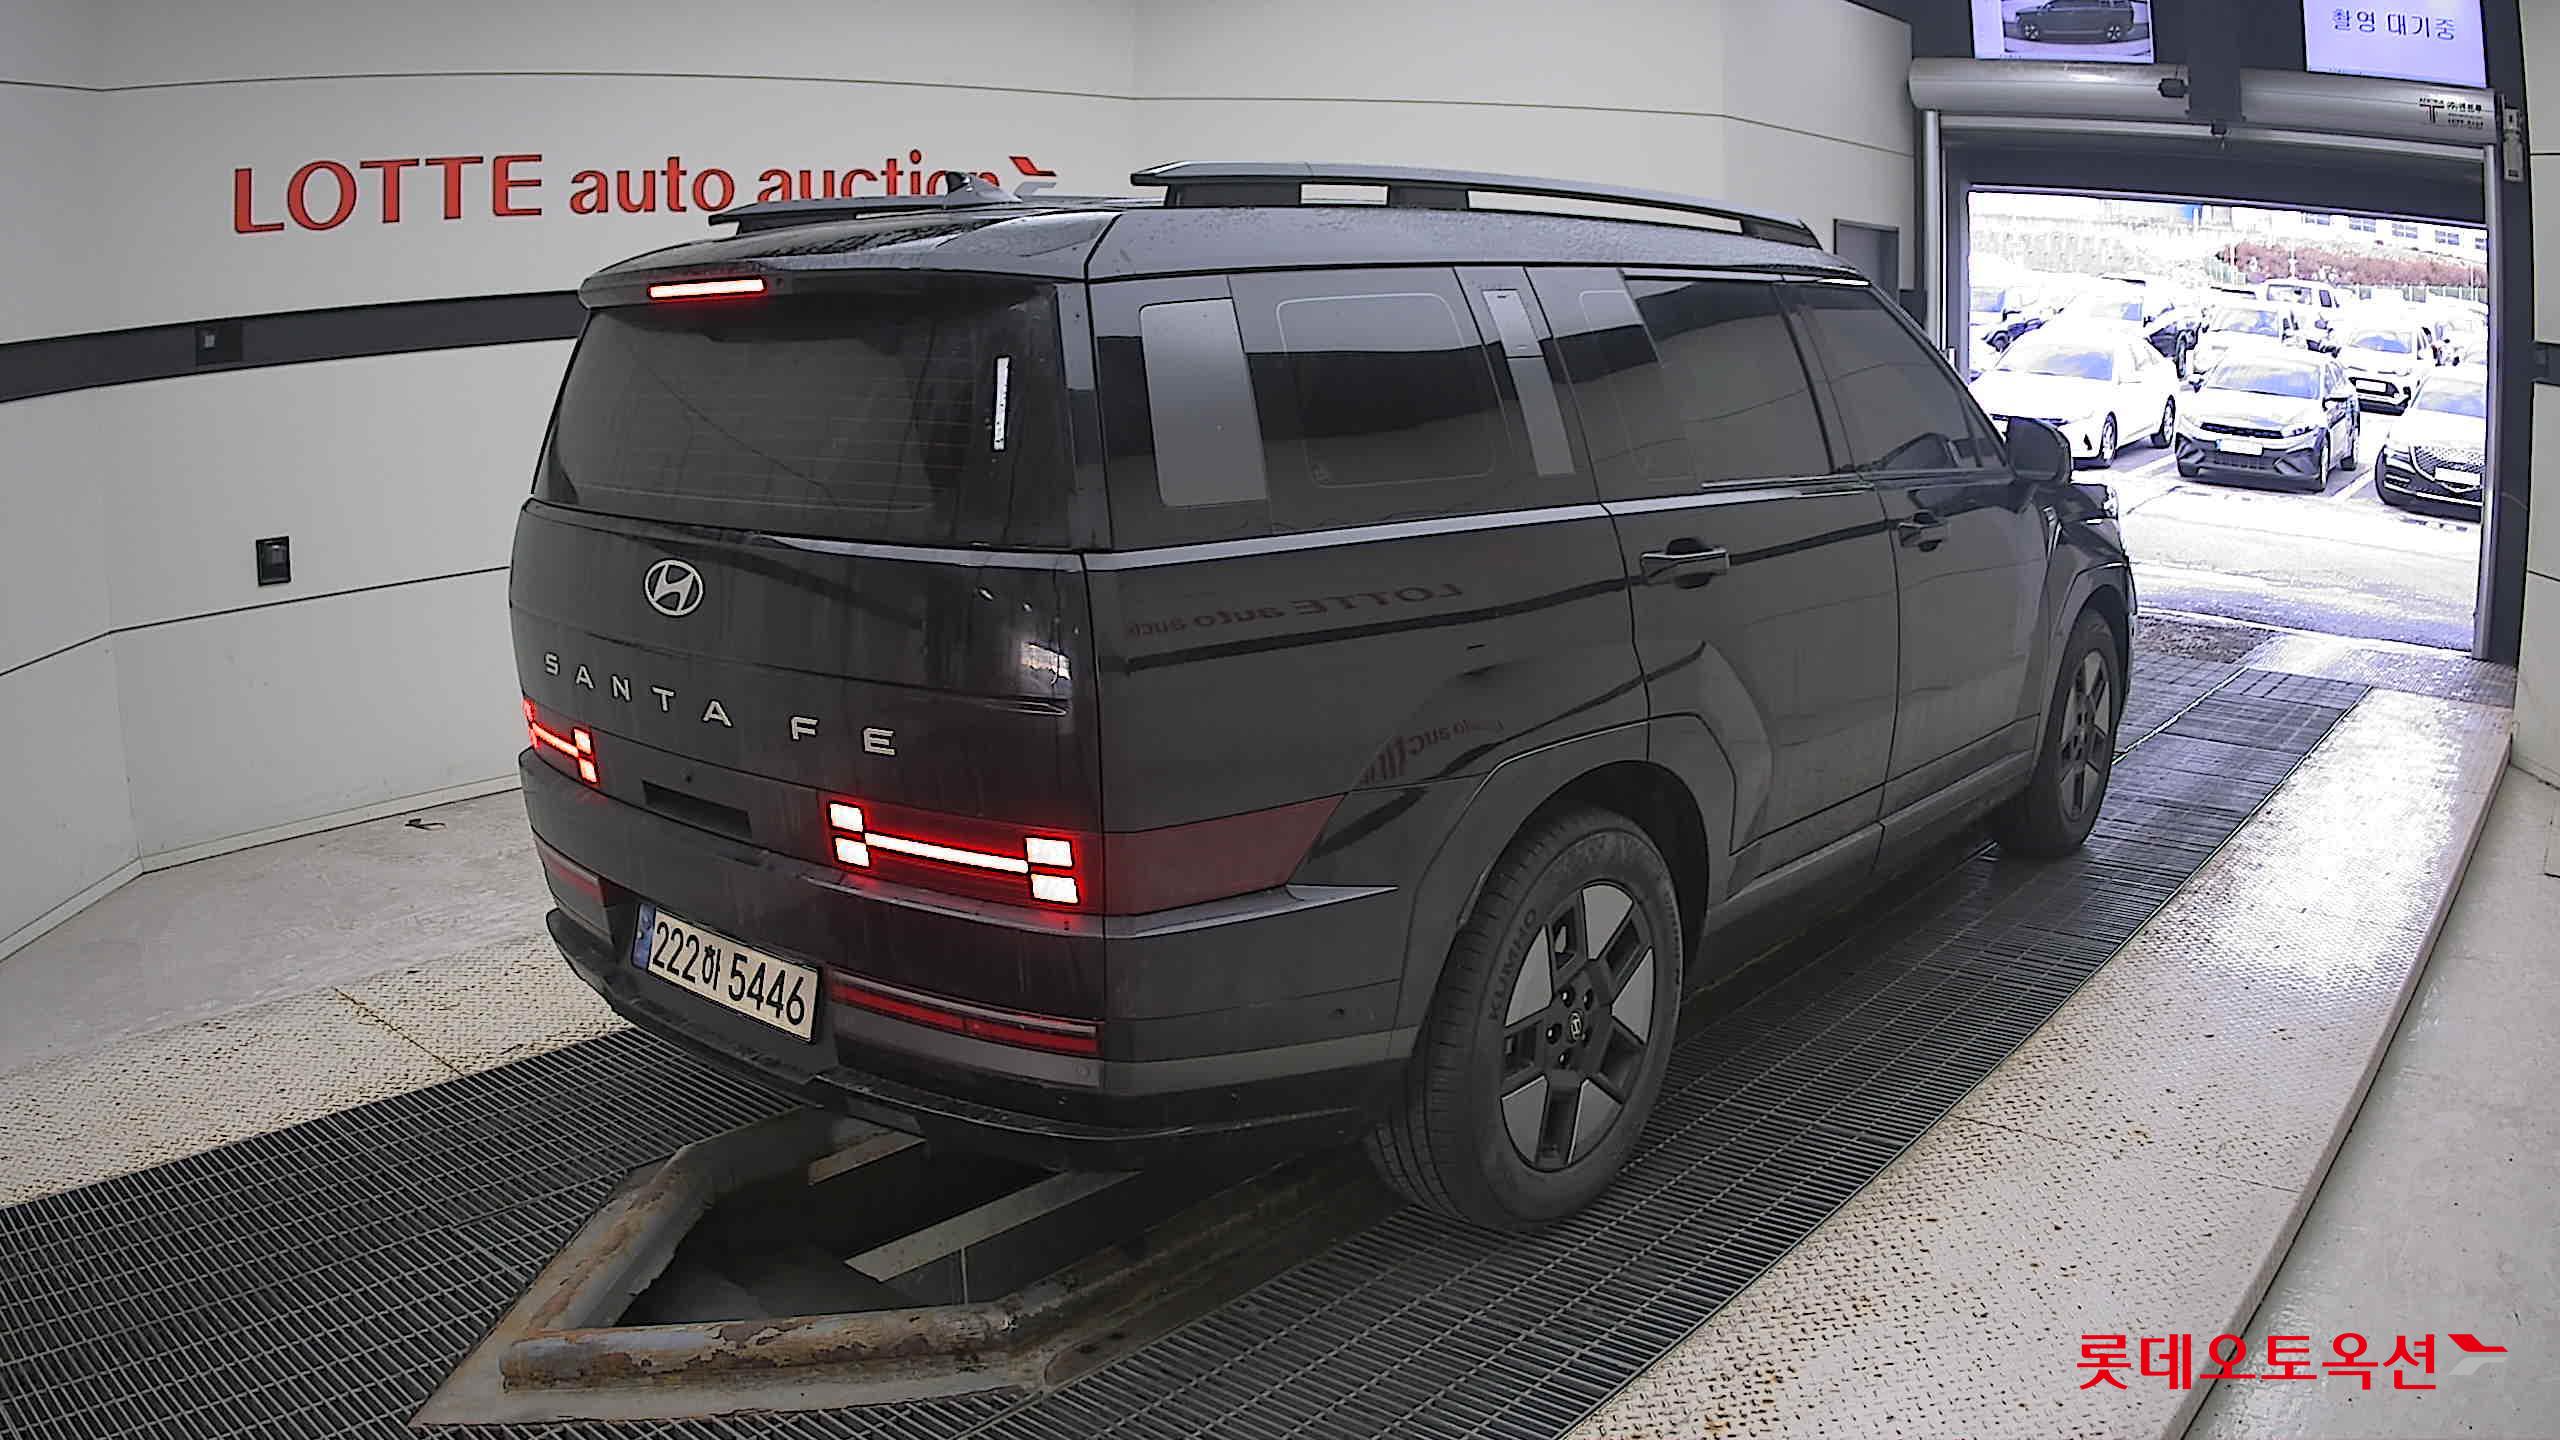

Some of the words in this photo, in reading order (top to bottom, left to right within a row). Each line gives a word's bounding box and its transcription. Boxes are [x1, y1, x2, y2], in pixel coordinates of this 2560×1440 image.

[2386, 12, 2456, 41] 대기중
[234, 153, 543, 234] LOTTE
[569, 155, 735, 212] auto
[544, 652, 732, 728] SANTA
[789, 715, 897, 757] FE
[652, 921, 722, 991] 222하
[728, 952, 805, 1026] 5446
